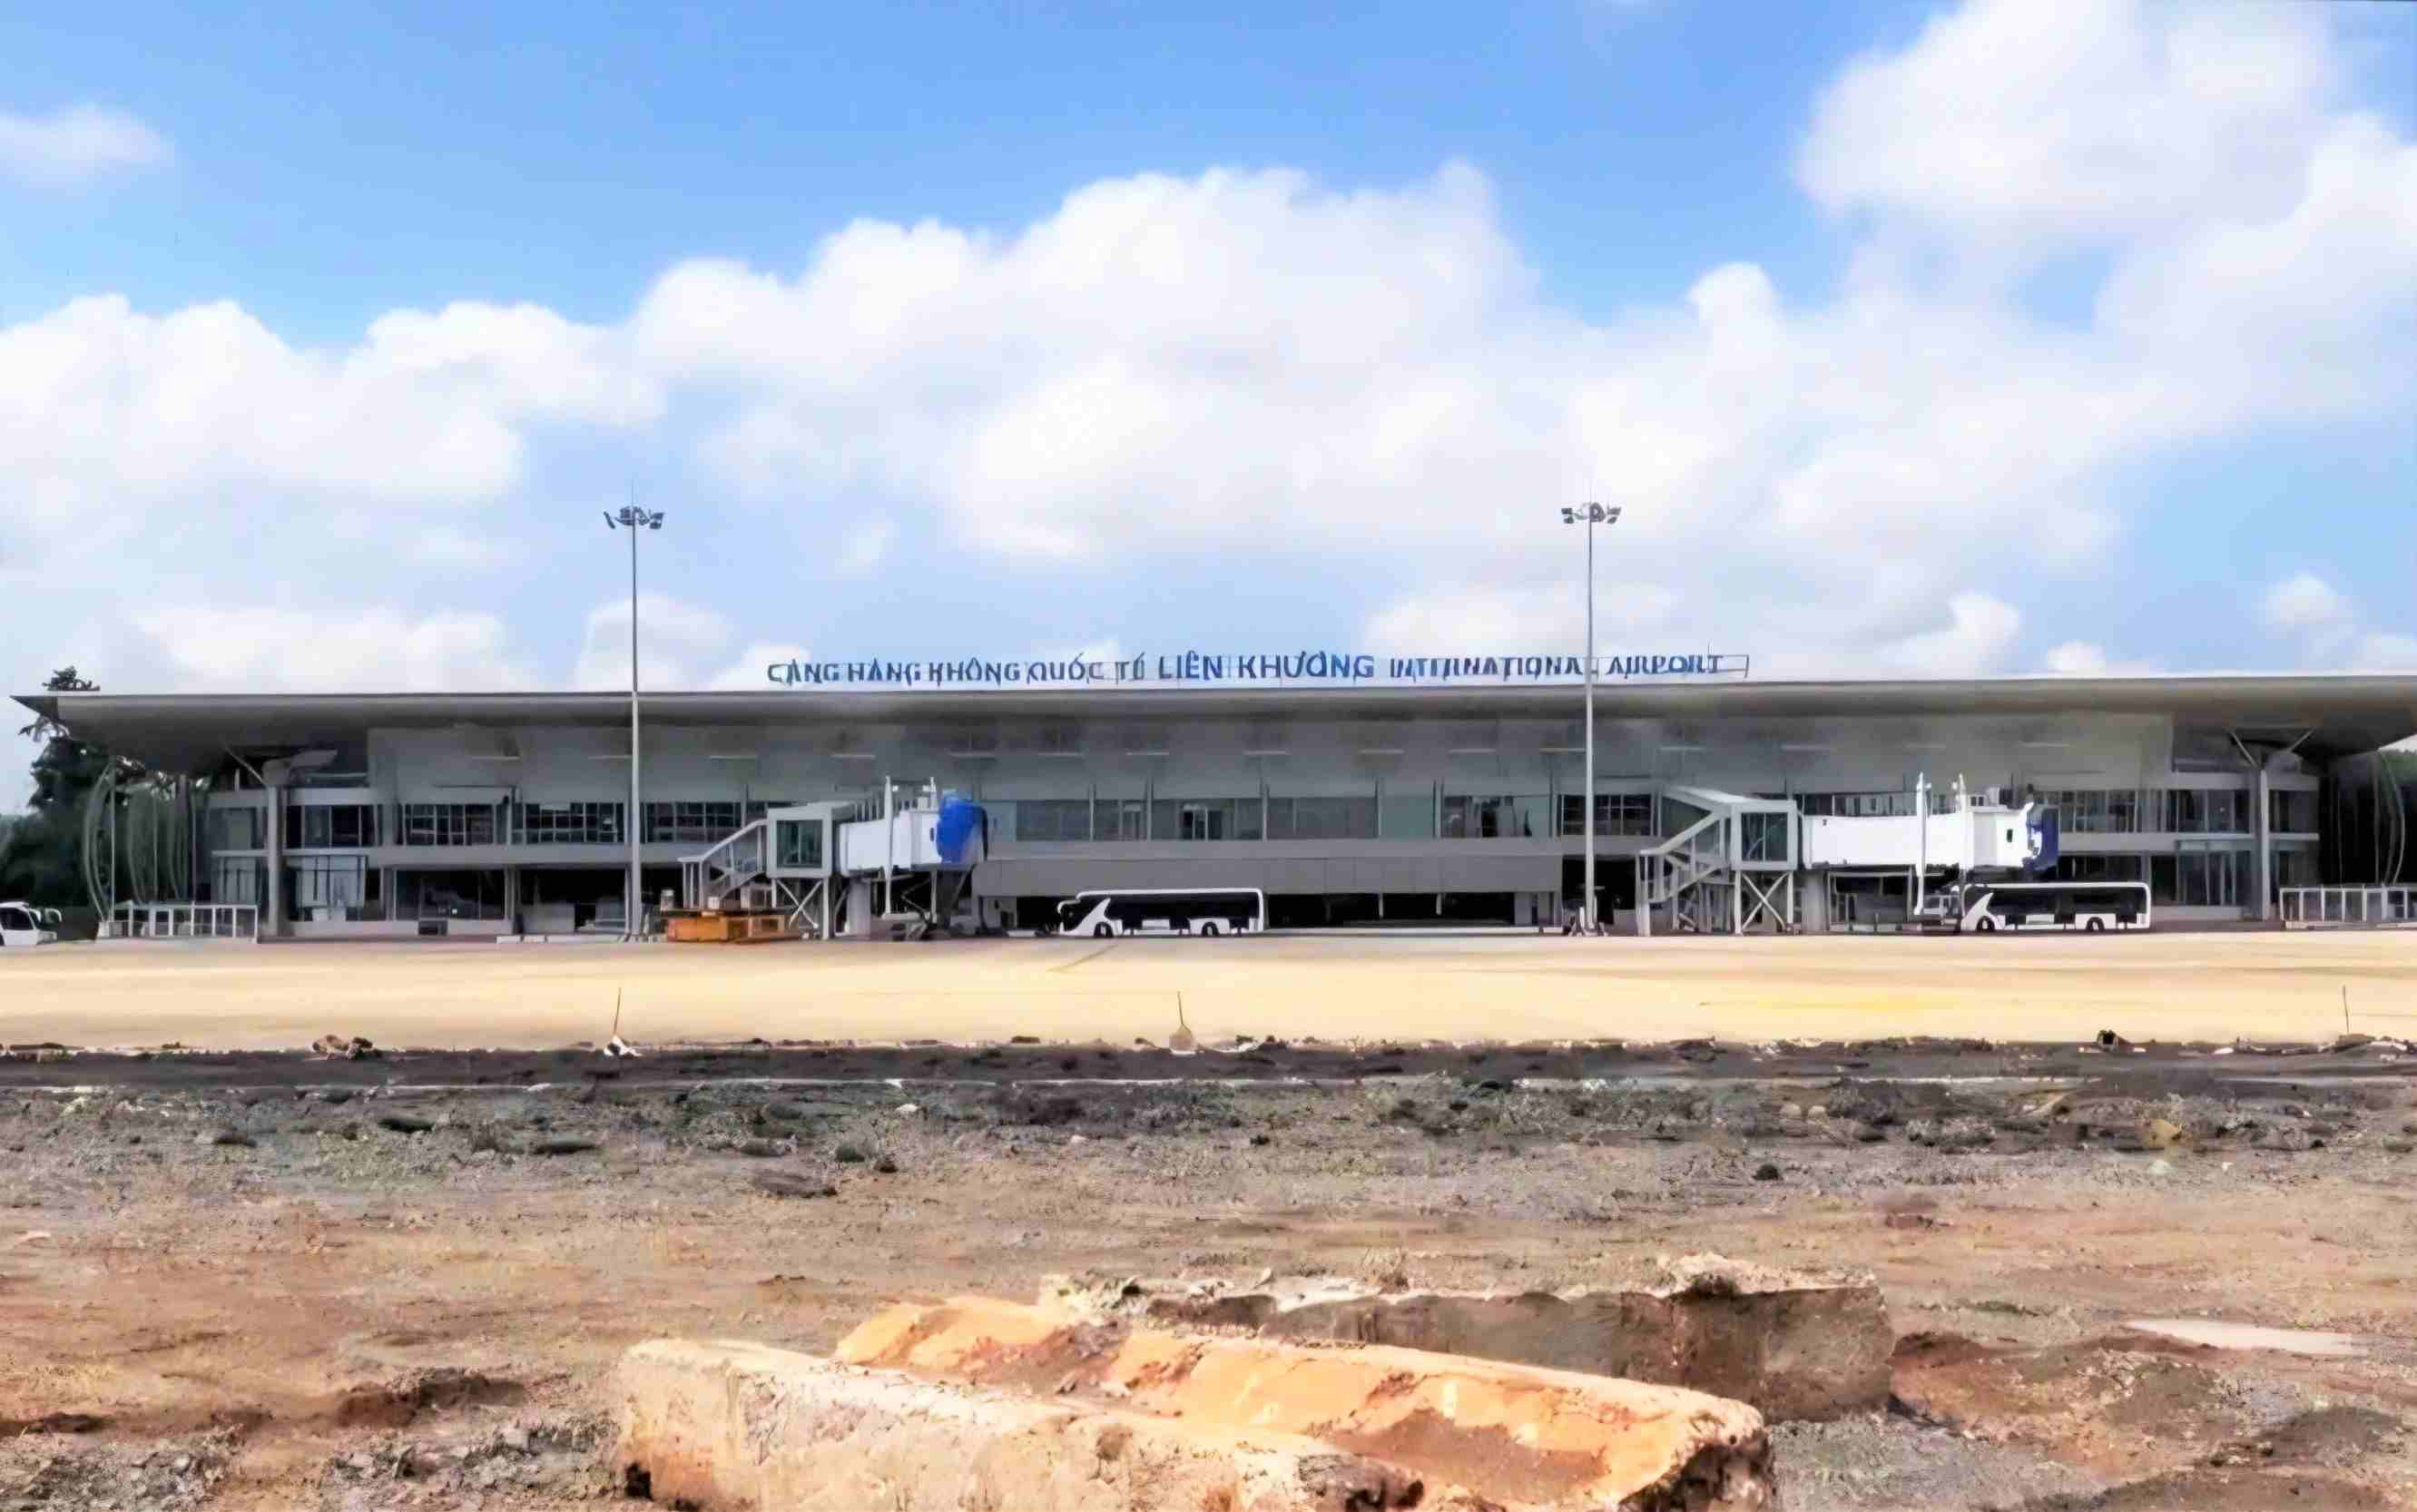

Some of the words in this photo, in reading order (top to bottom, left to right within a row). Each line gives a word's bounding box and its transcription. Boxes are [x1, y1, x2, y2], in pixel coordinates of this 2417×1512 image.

[928, 656, 1020, 683] KHÔNG
[1157, 649, 1223, 681] LIÊN
[1606, 653, 1724, 676] AIRPORT
